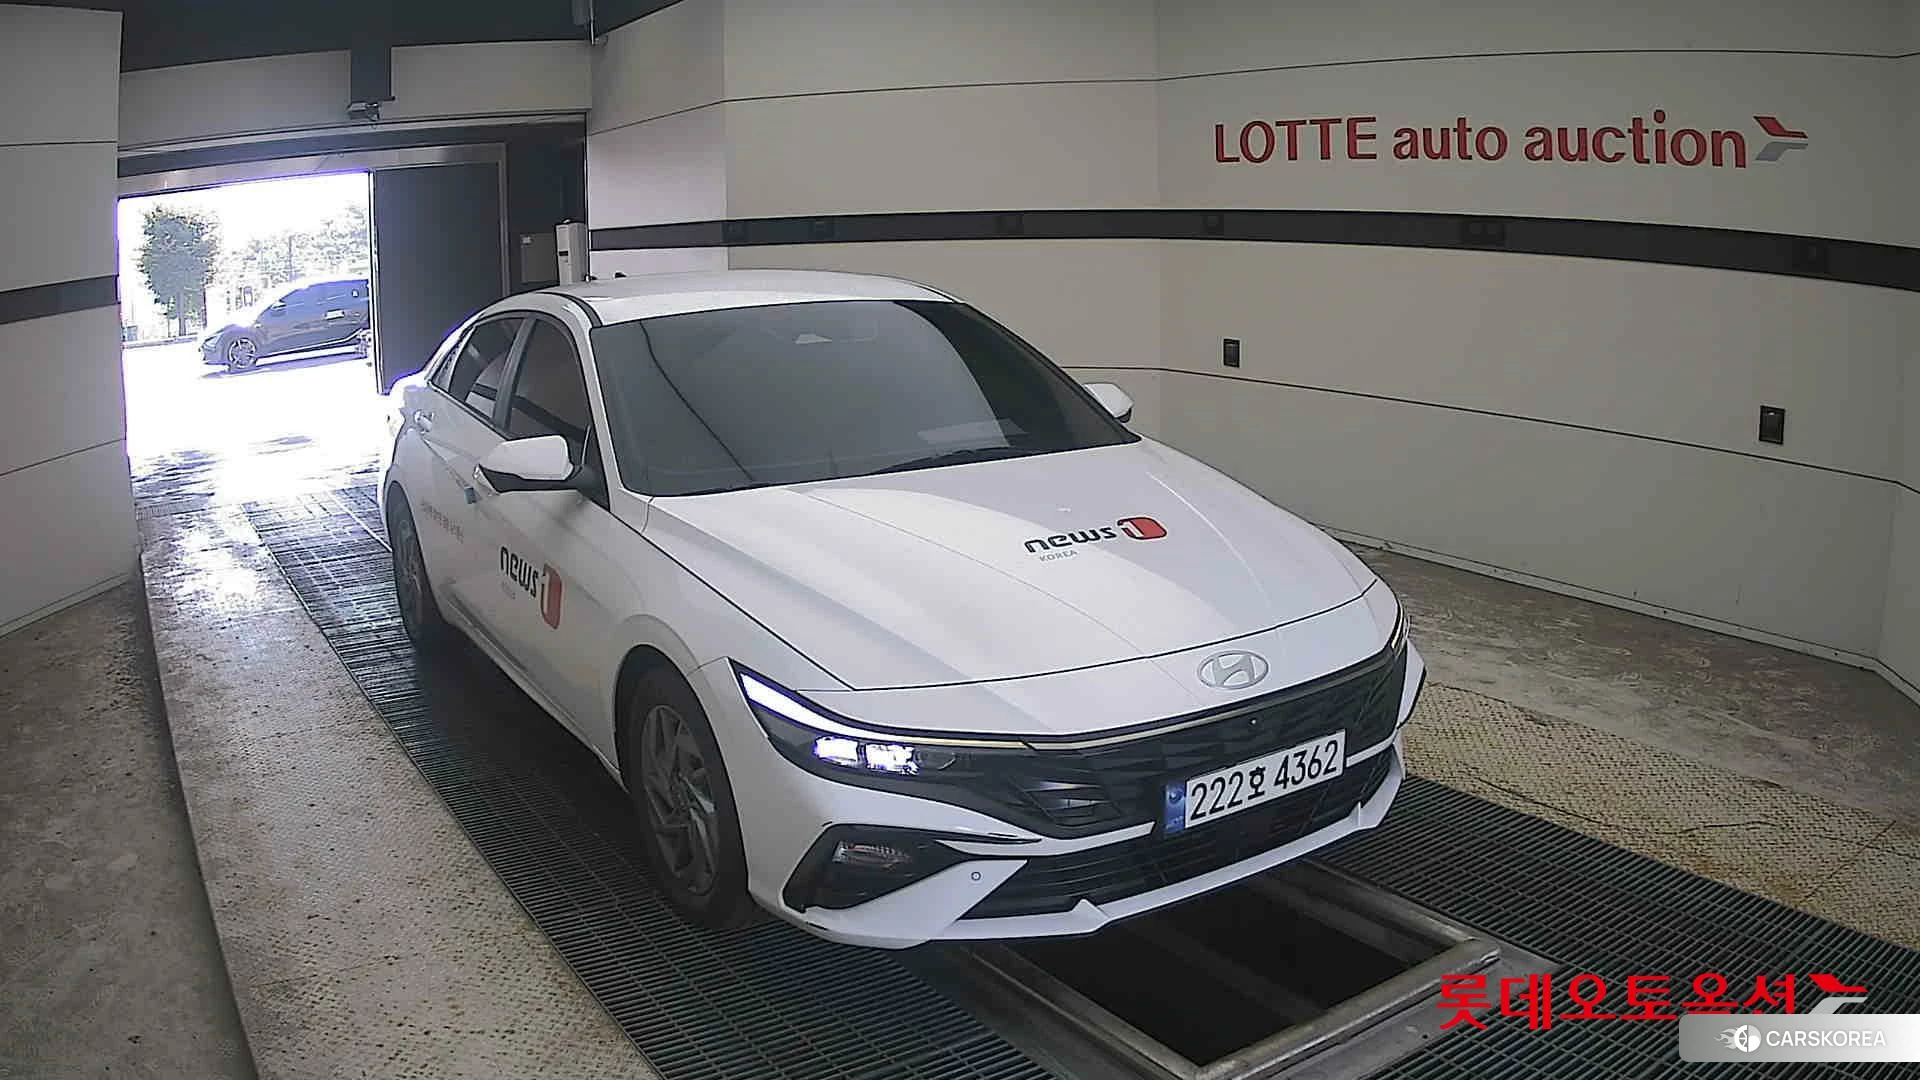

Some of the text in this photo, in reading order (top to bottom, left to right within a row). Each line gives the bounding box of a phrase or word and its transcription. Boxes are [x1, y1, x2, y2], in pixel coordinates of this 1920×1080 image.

[1215, 109, 1747, 168] LOTTE auto auction
[1039, 549, 1078, 562] KOREA
[1190, 740, 1338, 820] 222호 4362
